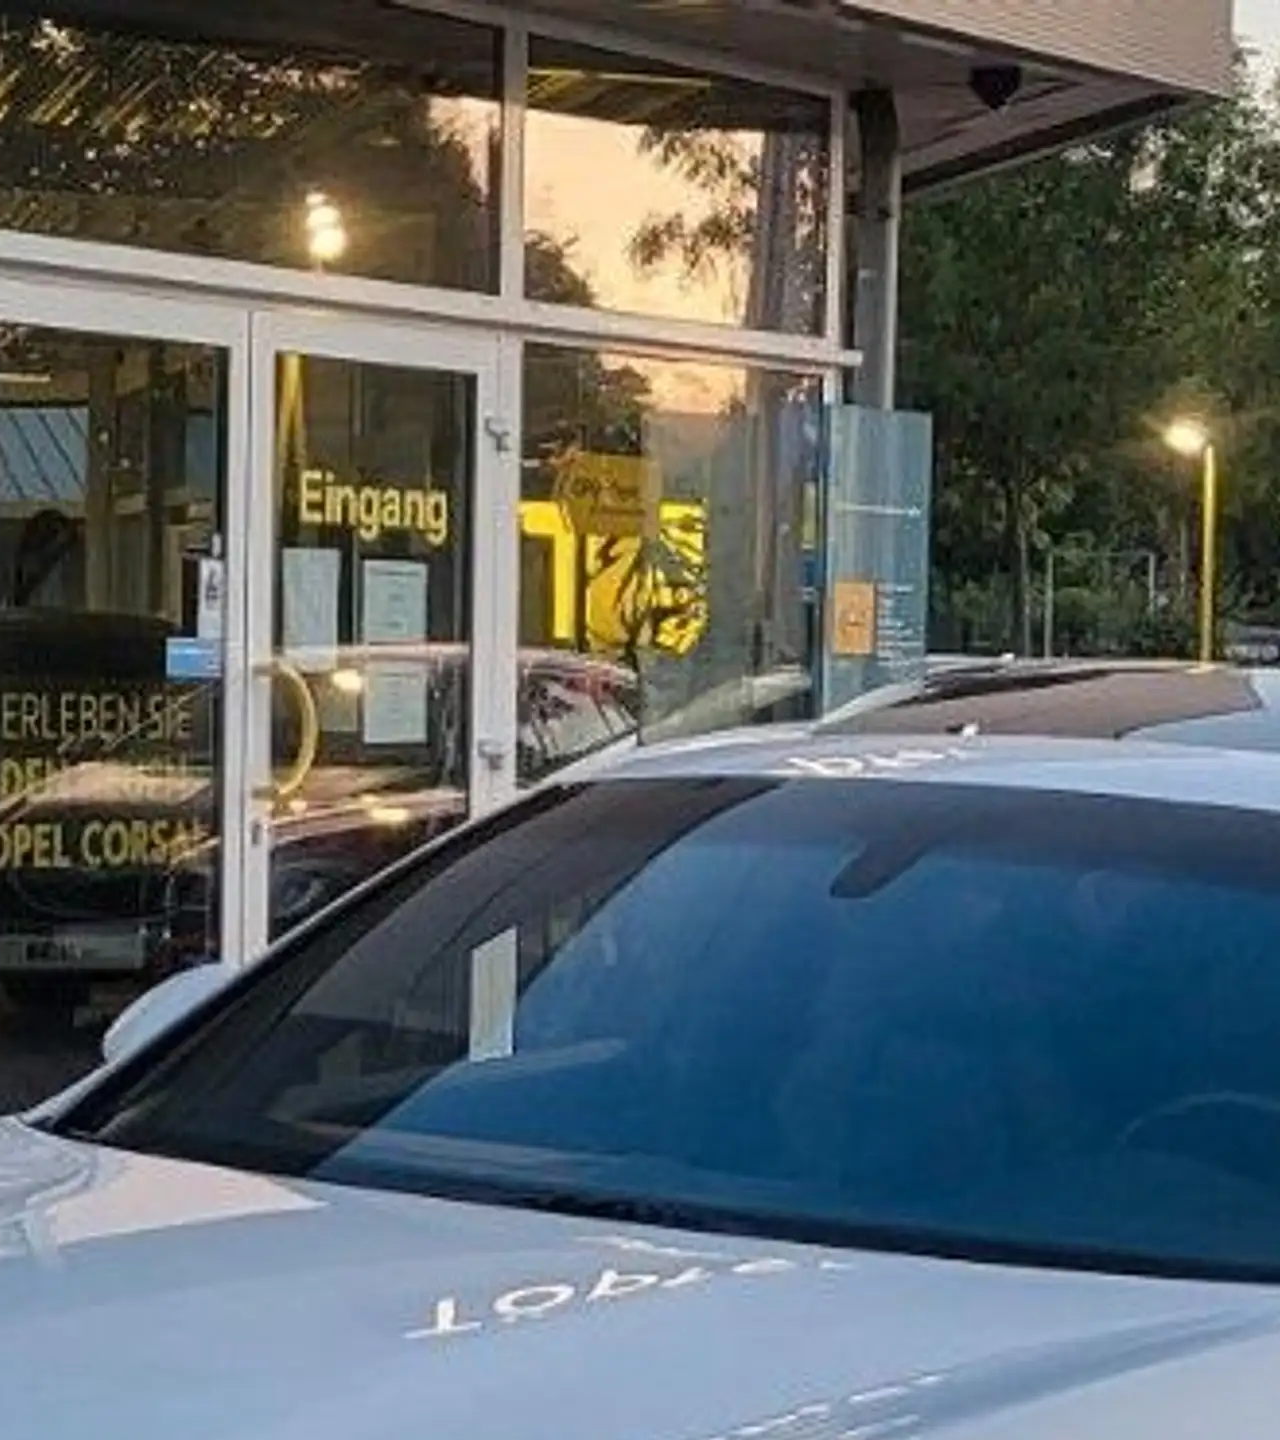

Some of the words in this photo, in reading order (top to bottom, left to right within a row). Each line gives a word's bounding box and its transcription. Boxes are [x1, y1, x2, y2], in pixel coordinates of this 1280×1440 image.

[299, 470, 448, 546] Eingang
[1, 690, 140, 741] ERLEBEN
[147, 696, 193, 740] SIE
